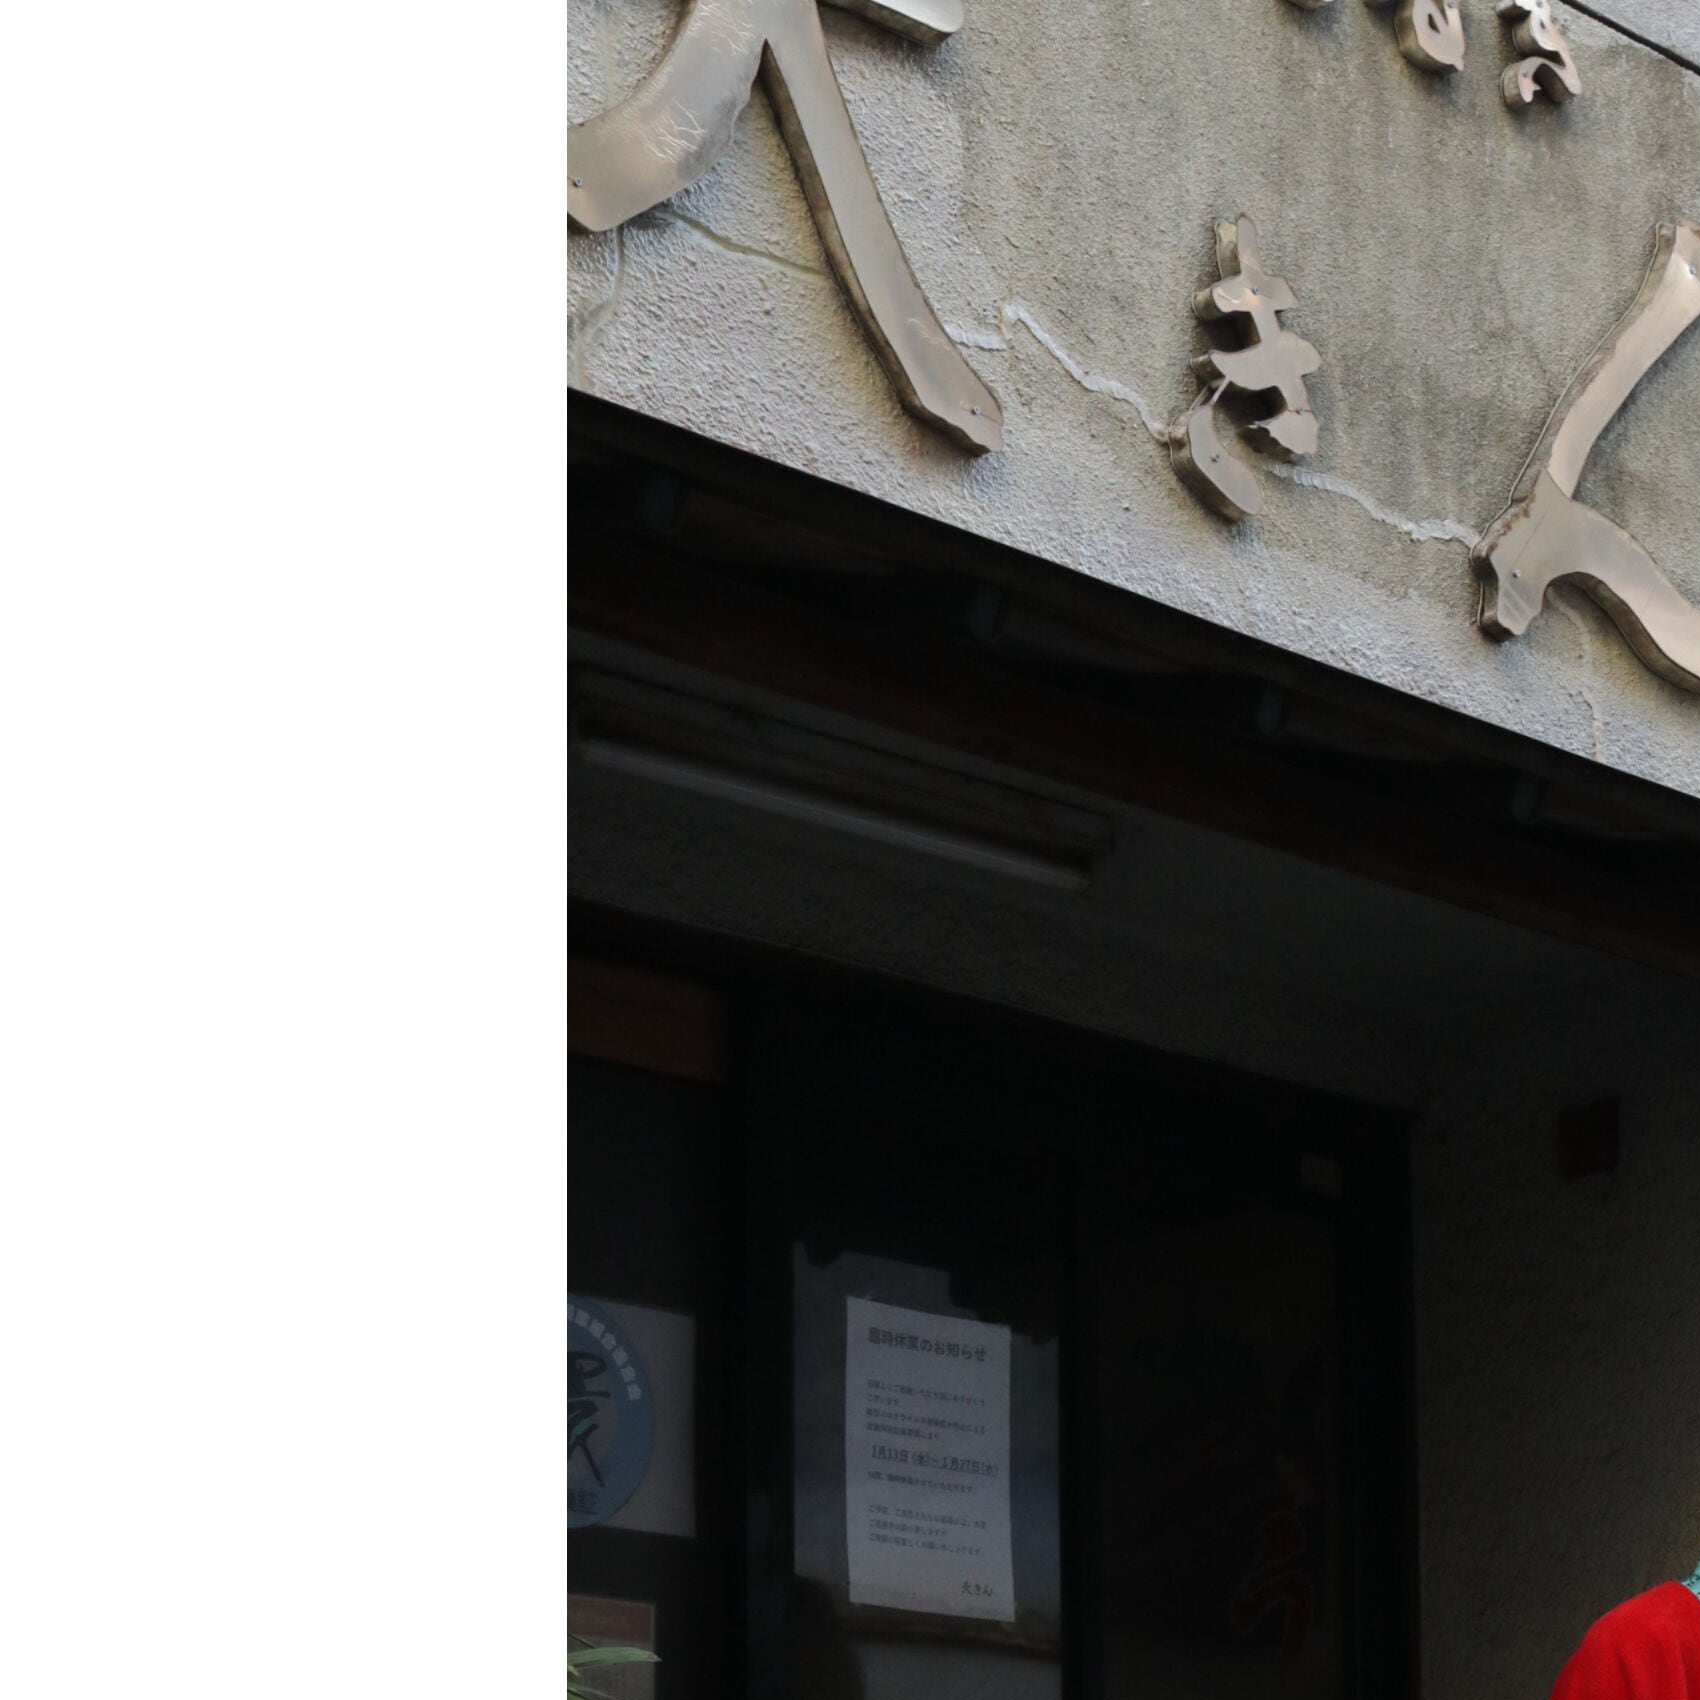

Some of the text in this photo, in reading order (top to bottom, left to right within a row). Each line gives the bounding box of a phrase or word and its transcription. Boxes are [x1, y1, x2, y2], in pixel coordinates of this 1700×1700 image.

[867, 1326, 987, 1362] 臨時休業のお知らせ
